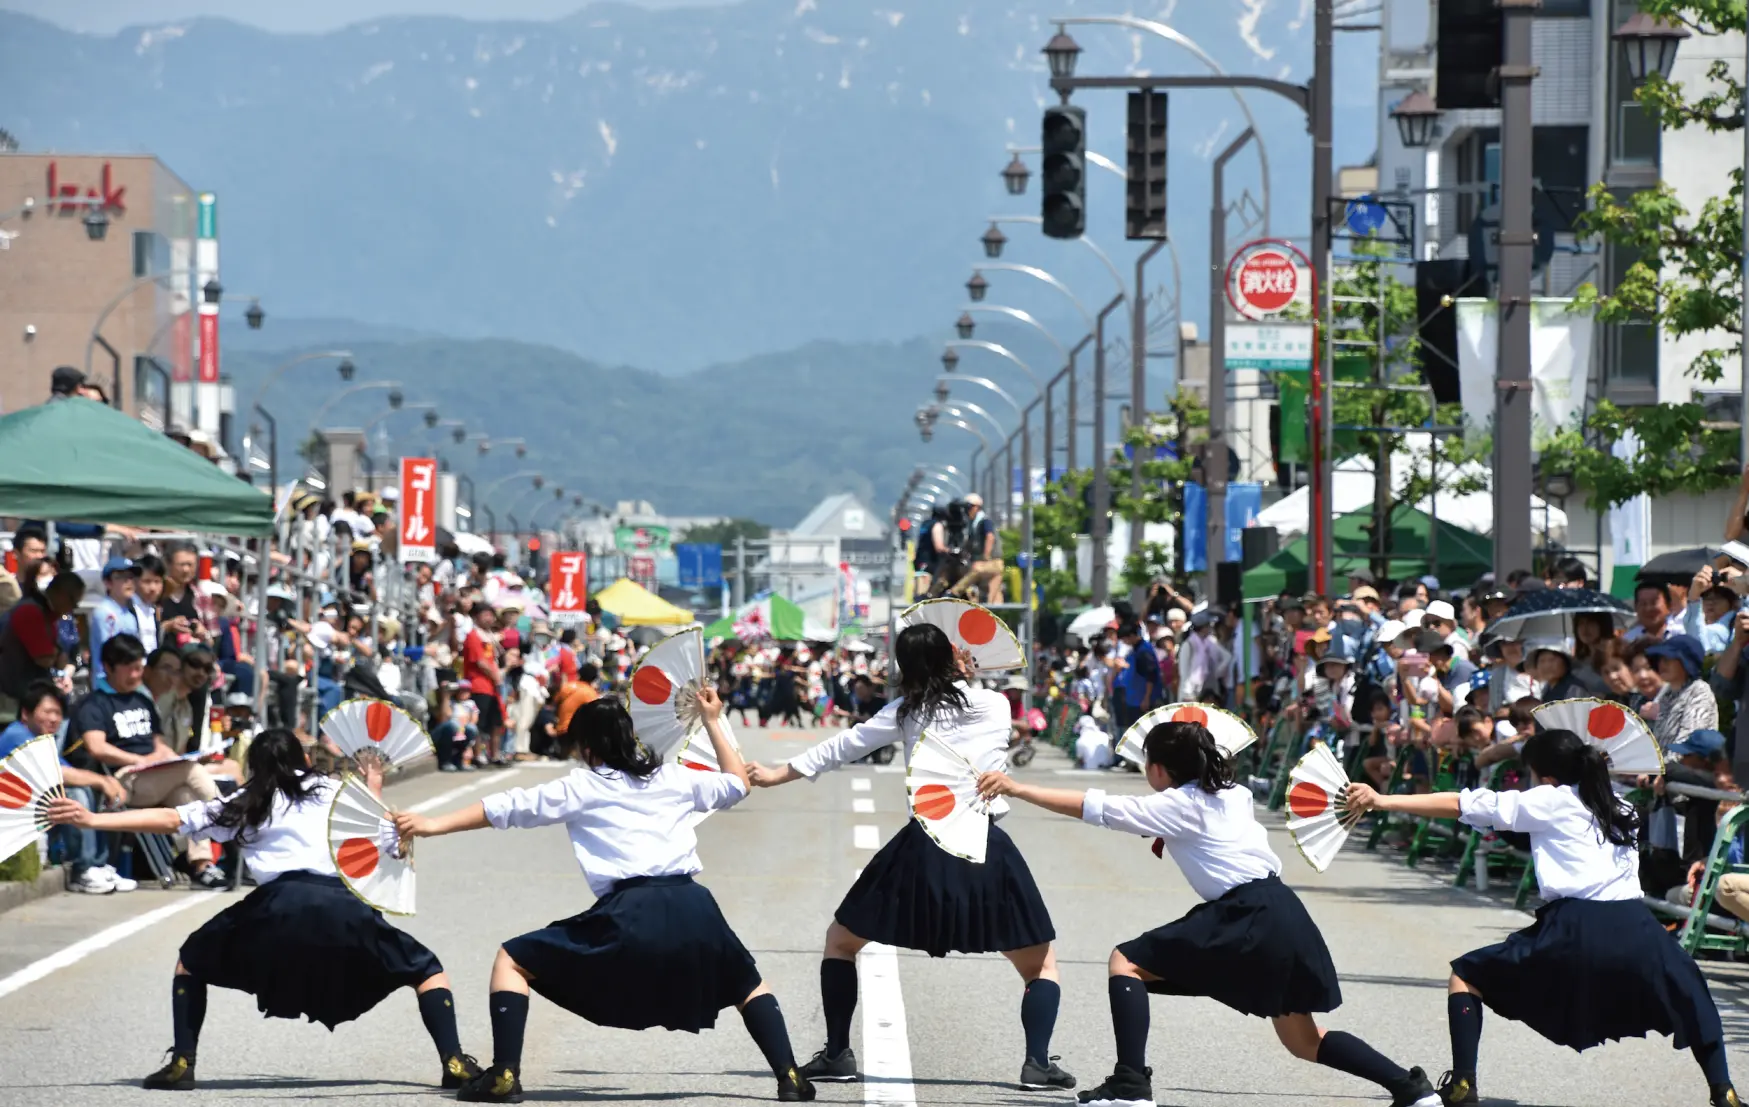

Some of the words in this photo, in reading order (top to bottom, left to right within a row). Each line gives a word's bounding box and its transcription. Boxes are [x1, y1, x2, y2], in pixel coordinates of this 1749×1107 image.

[1242, 268, 1294, 294] 消火栓
[405, 463, 434, 542] ゴール
[554, 555, 583, 609] ゴール
